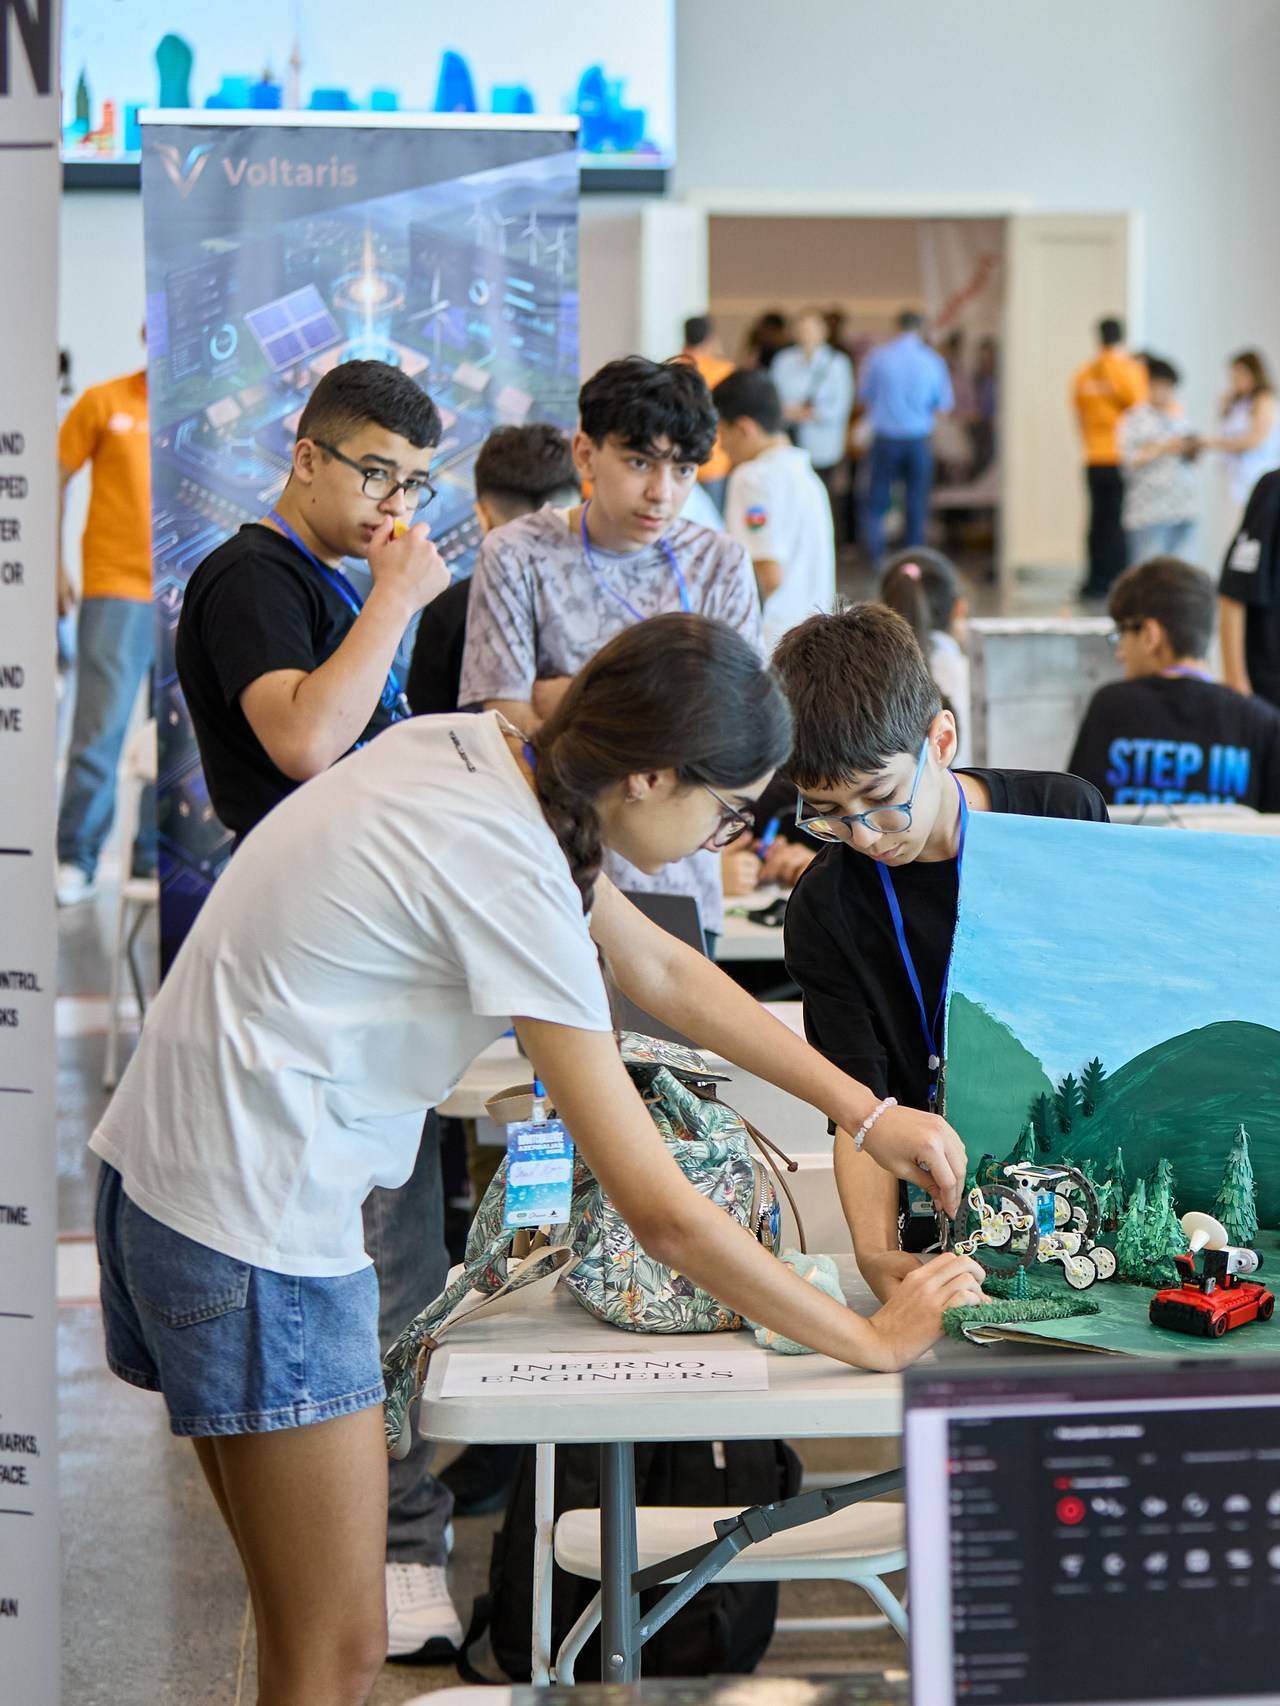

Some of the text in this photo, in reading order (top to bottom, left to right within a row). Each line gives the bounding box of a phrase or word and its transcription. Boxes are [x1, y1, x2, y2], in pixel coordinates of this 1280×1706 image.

[223, 154, 358, 187] Voltaris
[1, 561, 24, 585] OR
[1106, 737, 1250, 797] STEP IN
[481, 1370, 733, 1383] ENGINEERS
[513, 1360, 705, 1373] INFERNO
